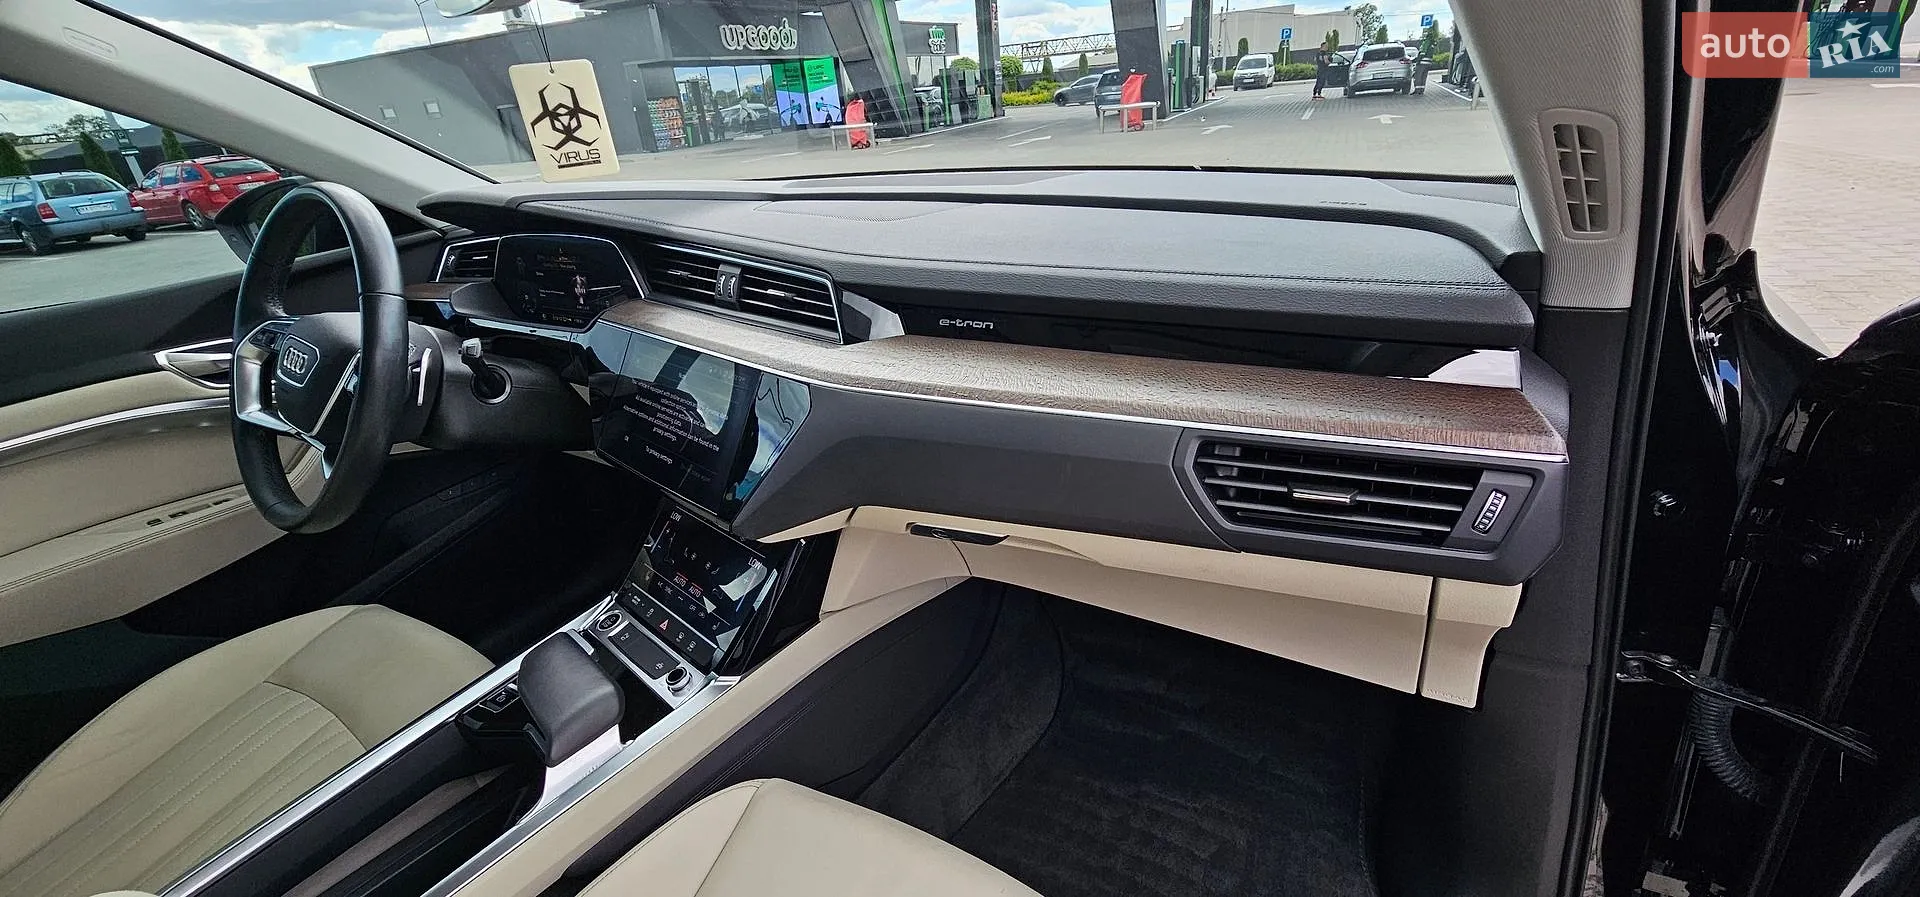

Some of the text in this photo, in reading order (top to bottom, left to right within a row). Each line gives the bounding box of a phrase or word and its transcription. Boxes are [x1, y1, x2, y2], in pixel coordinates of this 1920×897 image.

[550, 148, 600, 164] VIRUS
[940, 318, 994, 329] e-tron
[670, 511, 681, 522] LOW
[748, 556, 762, 569] LOW
[673, 575, 686, 587] AUTO
[688, 585, 702, 598] AUTO
